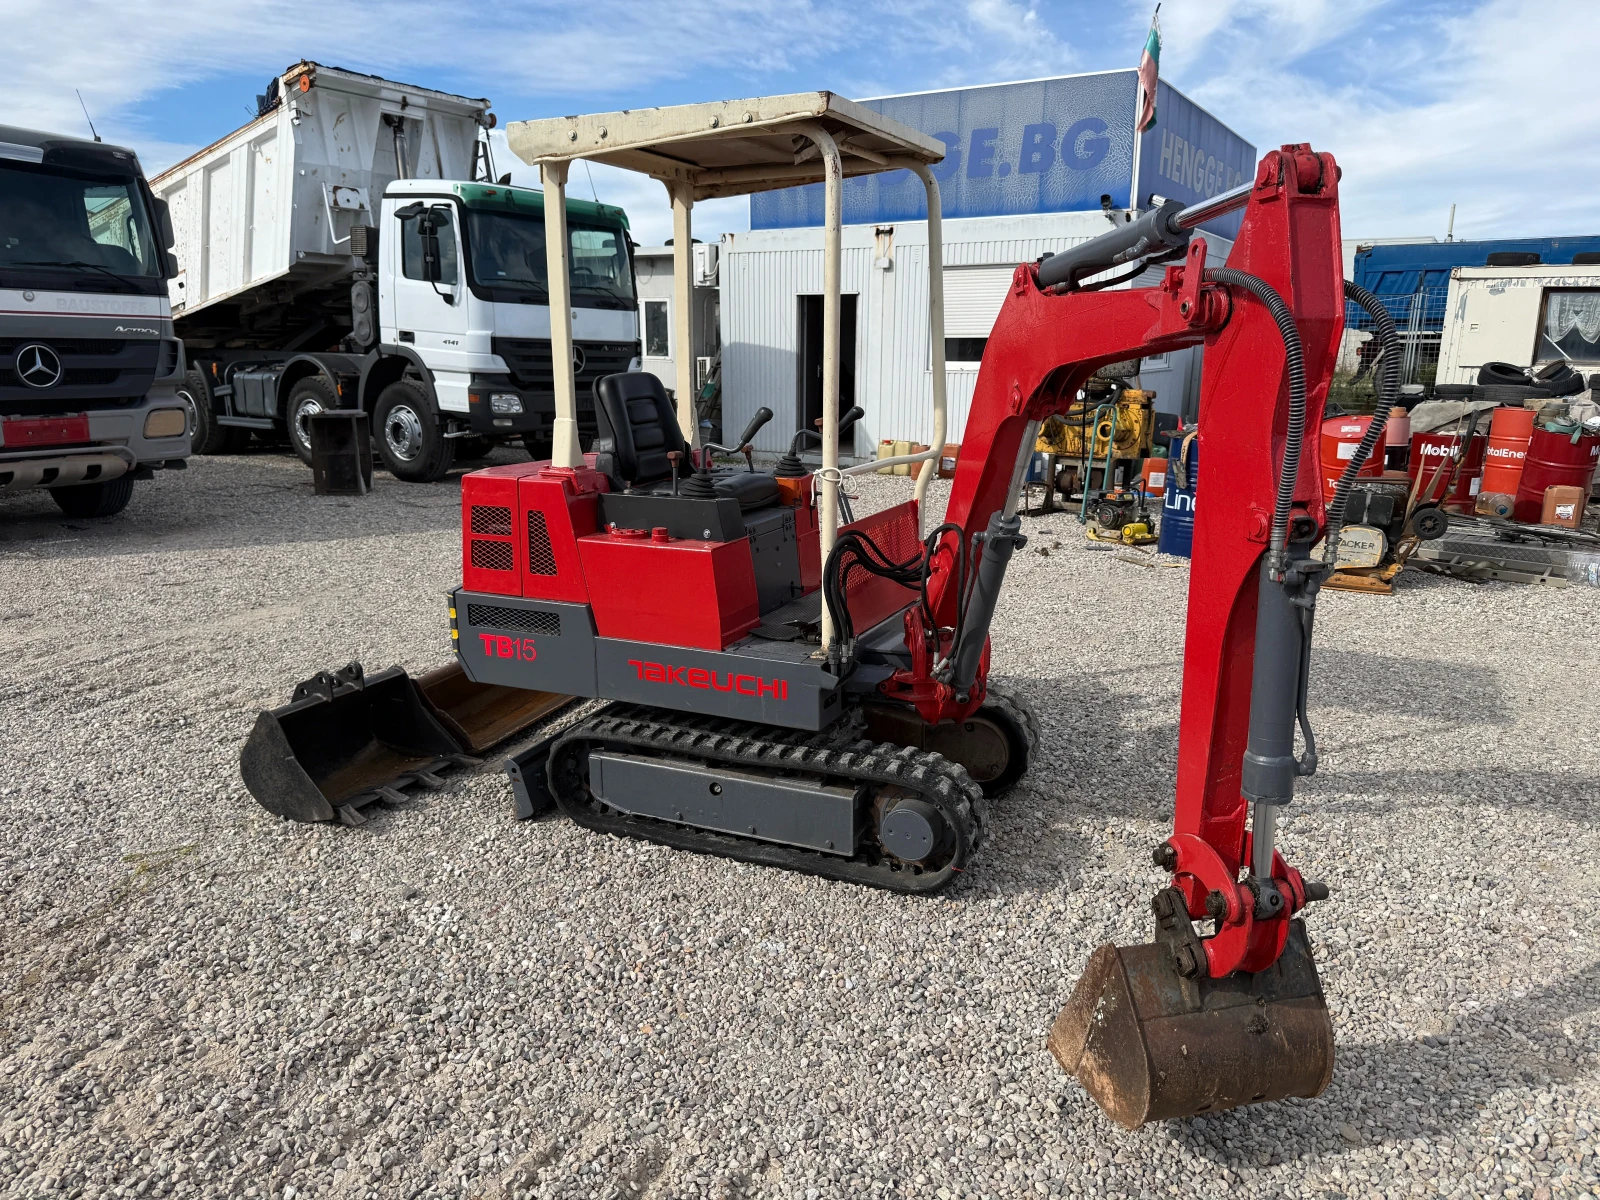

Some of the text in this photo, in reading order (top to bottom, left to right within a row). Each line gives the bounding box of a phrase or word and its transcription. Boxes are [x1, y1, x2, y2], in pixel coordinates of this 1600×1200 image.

[1419, 442, 1459, 457] Mobil
[1338, 538, 1375, 550] ACKER
[478, 633, 538, 662] TB15
